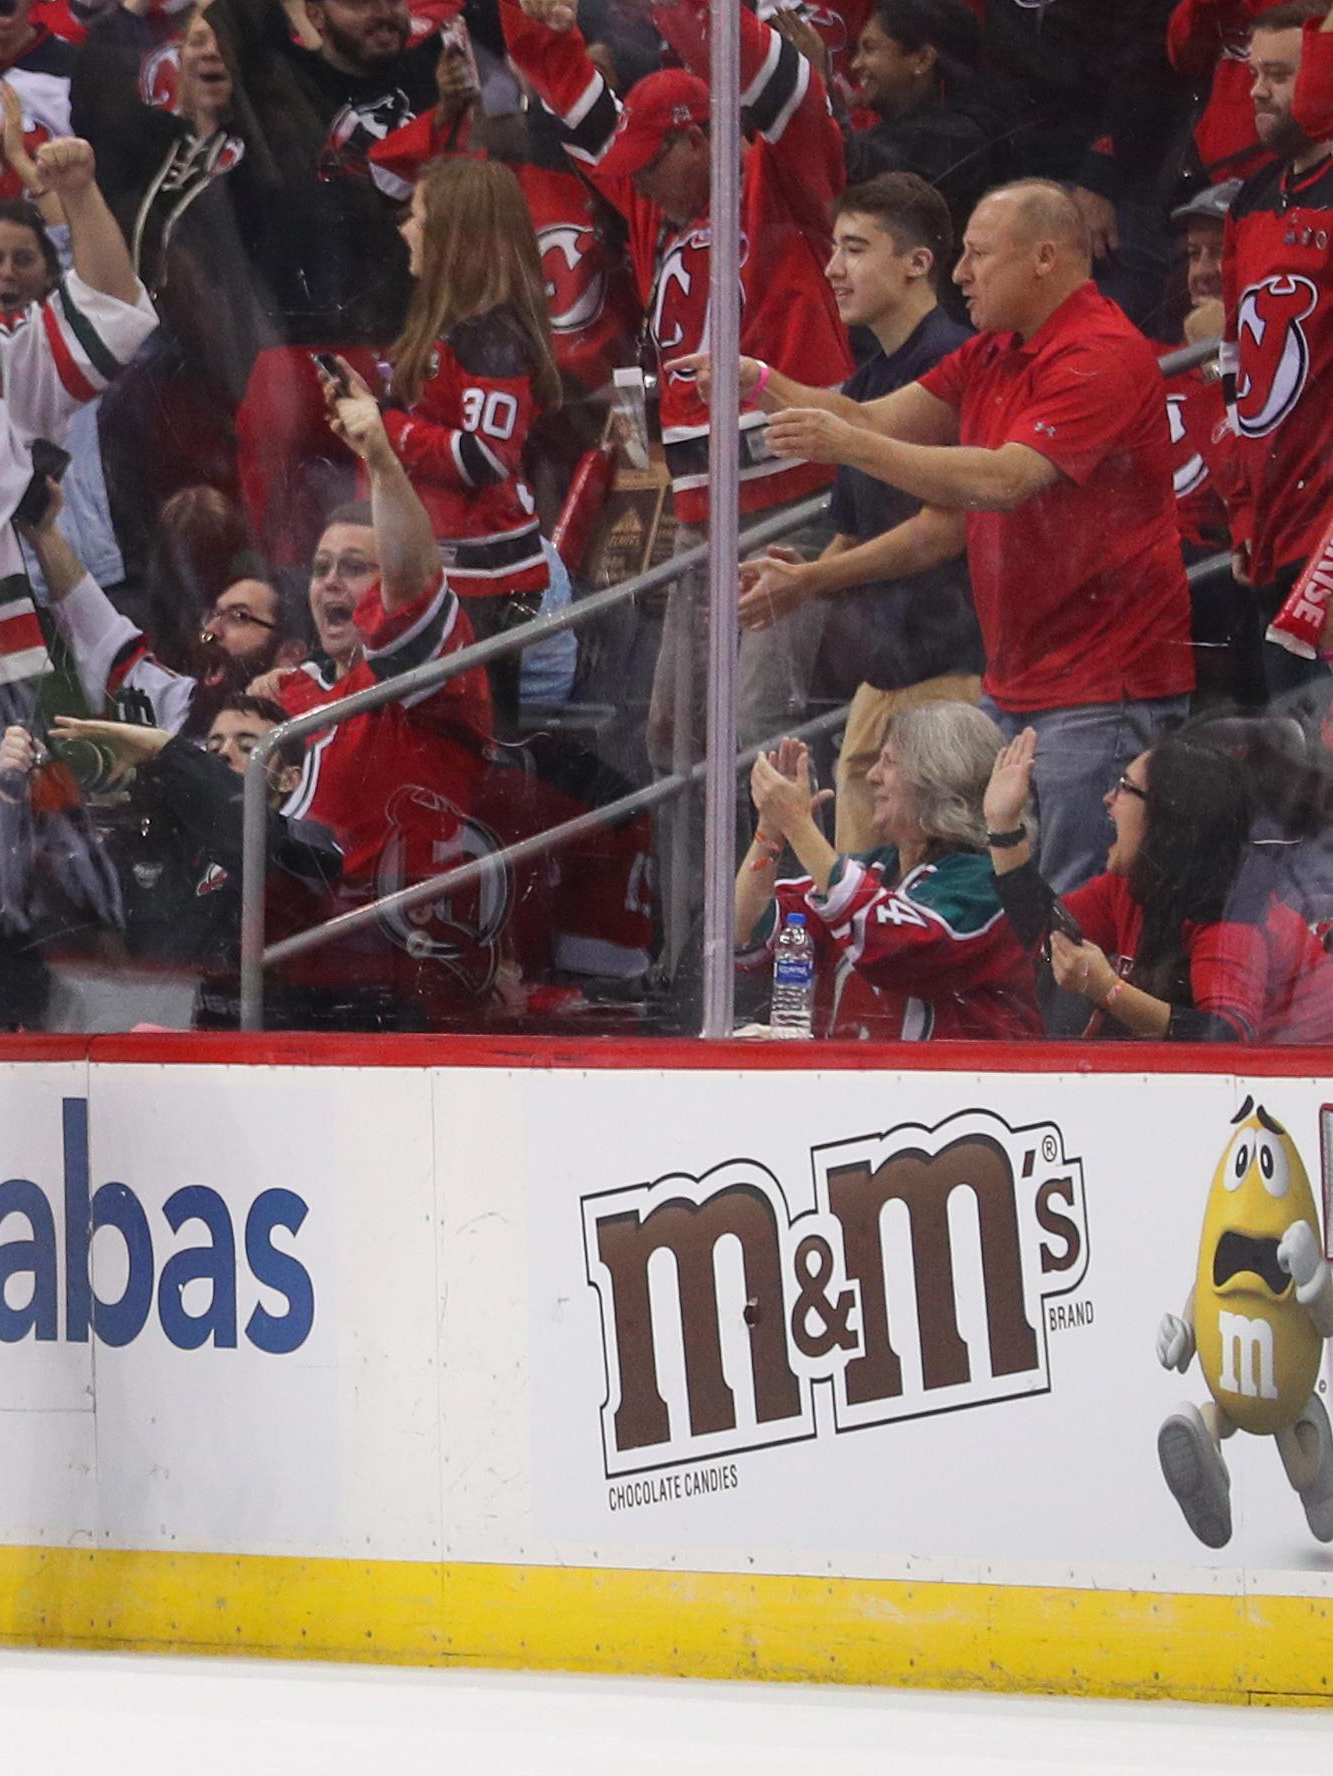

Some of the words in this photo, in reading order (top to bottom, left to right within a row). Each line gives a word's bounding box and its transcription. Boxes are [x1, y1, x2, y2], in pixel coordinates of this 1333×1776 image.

[462, 387, 518, 440] 30
[1048, 1300, 1094, 1331] BRAND
[1218, 1309, 1278, 1400] m
[609, 1476, 681, 1511] CHOCOLATE
[684, 1464, 739, 1497] CANDIES
